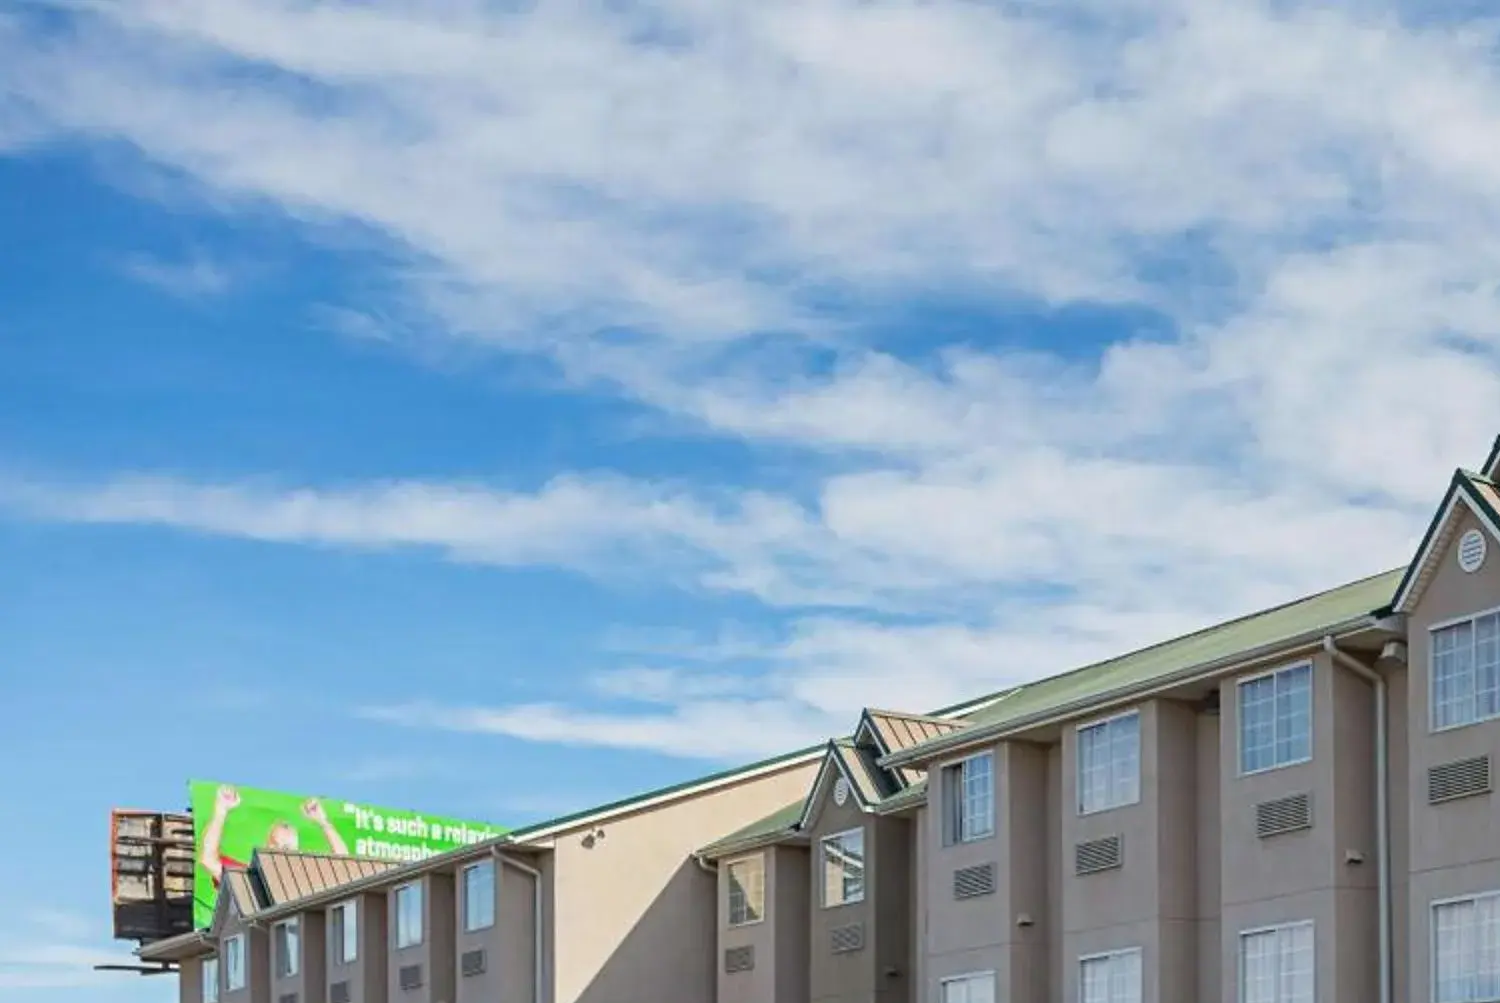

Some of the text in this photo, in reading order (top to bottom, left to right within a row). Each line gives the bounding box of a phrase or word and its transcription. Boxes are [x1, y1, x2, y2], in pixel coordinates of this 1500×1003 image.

[386, 815, 429, 839] such
[431, 823, 442, 841] a
[355, 835, 440, 862] atmosph
